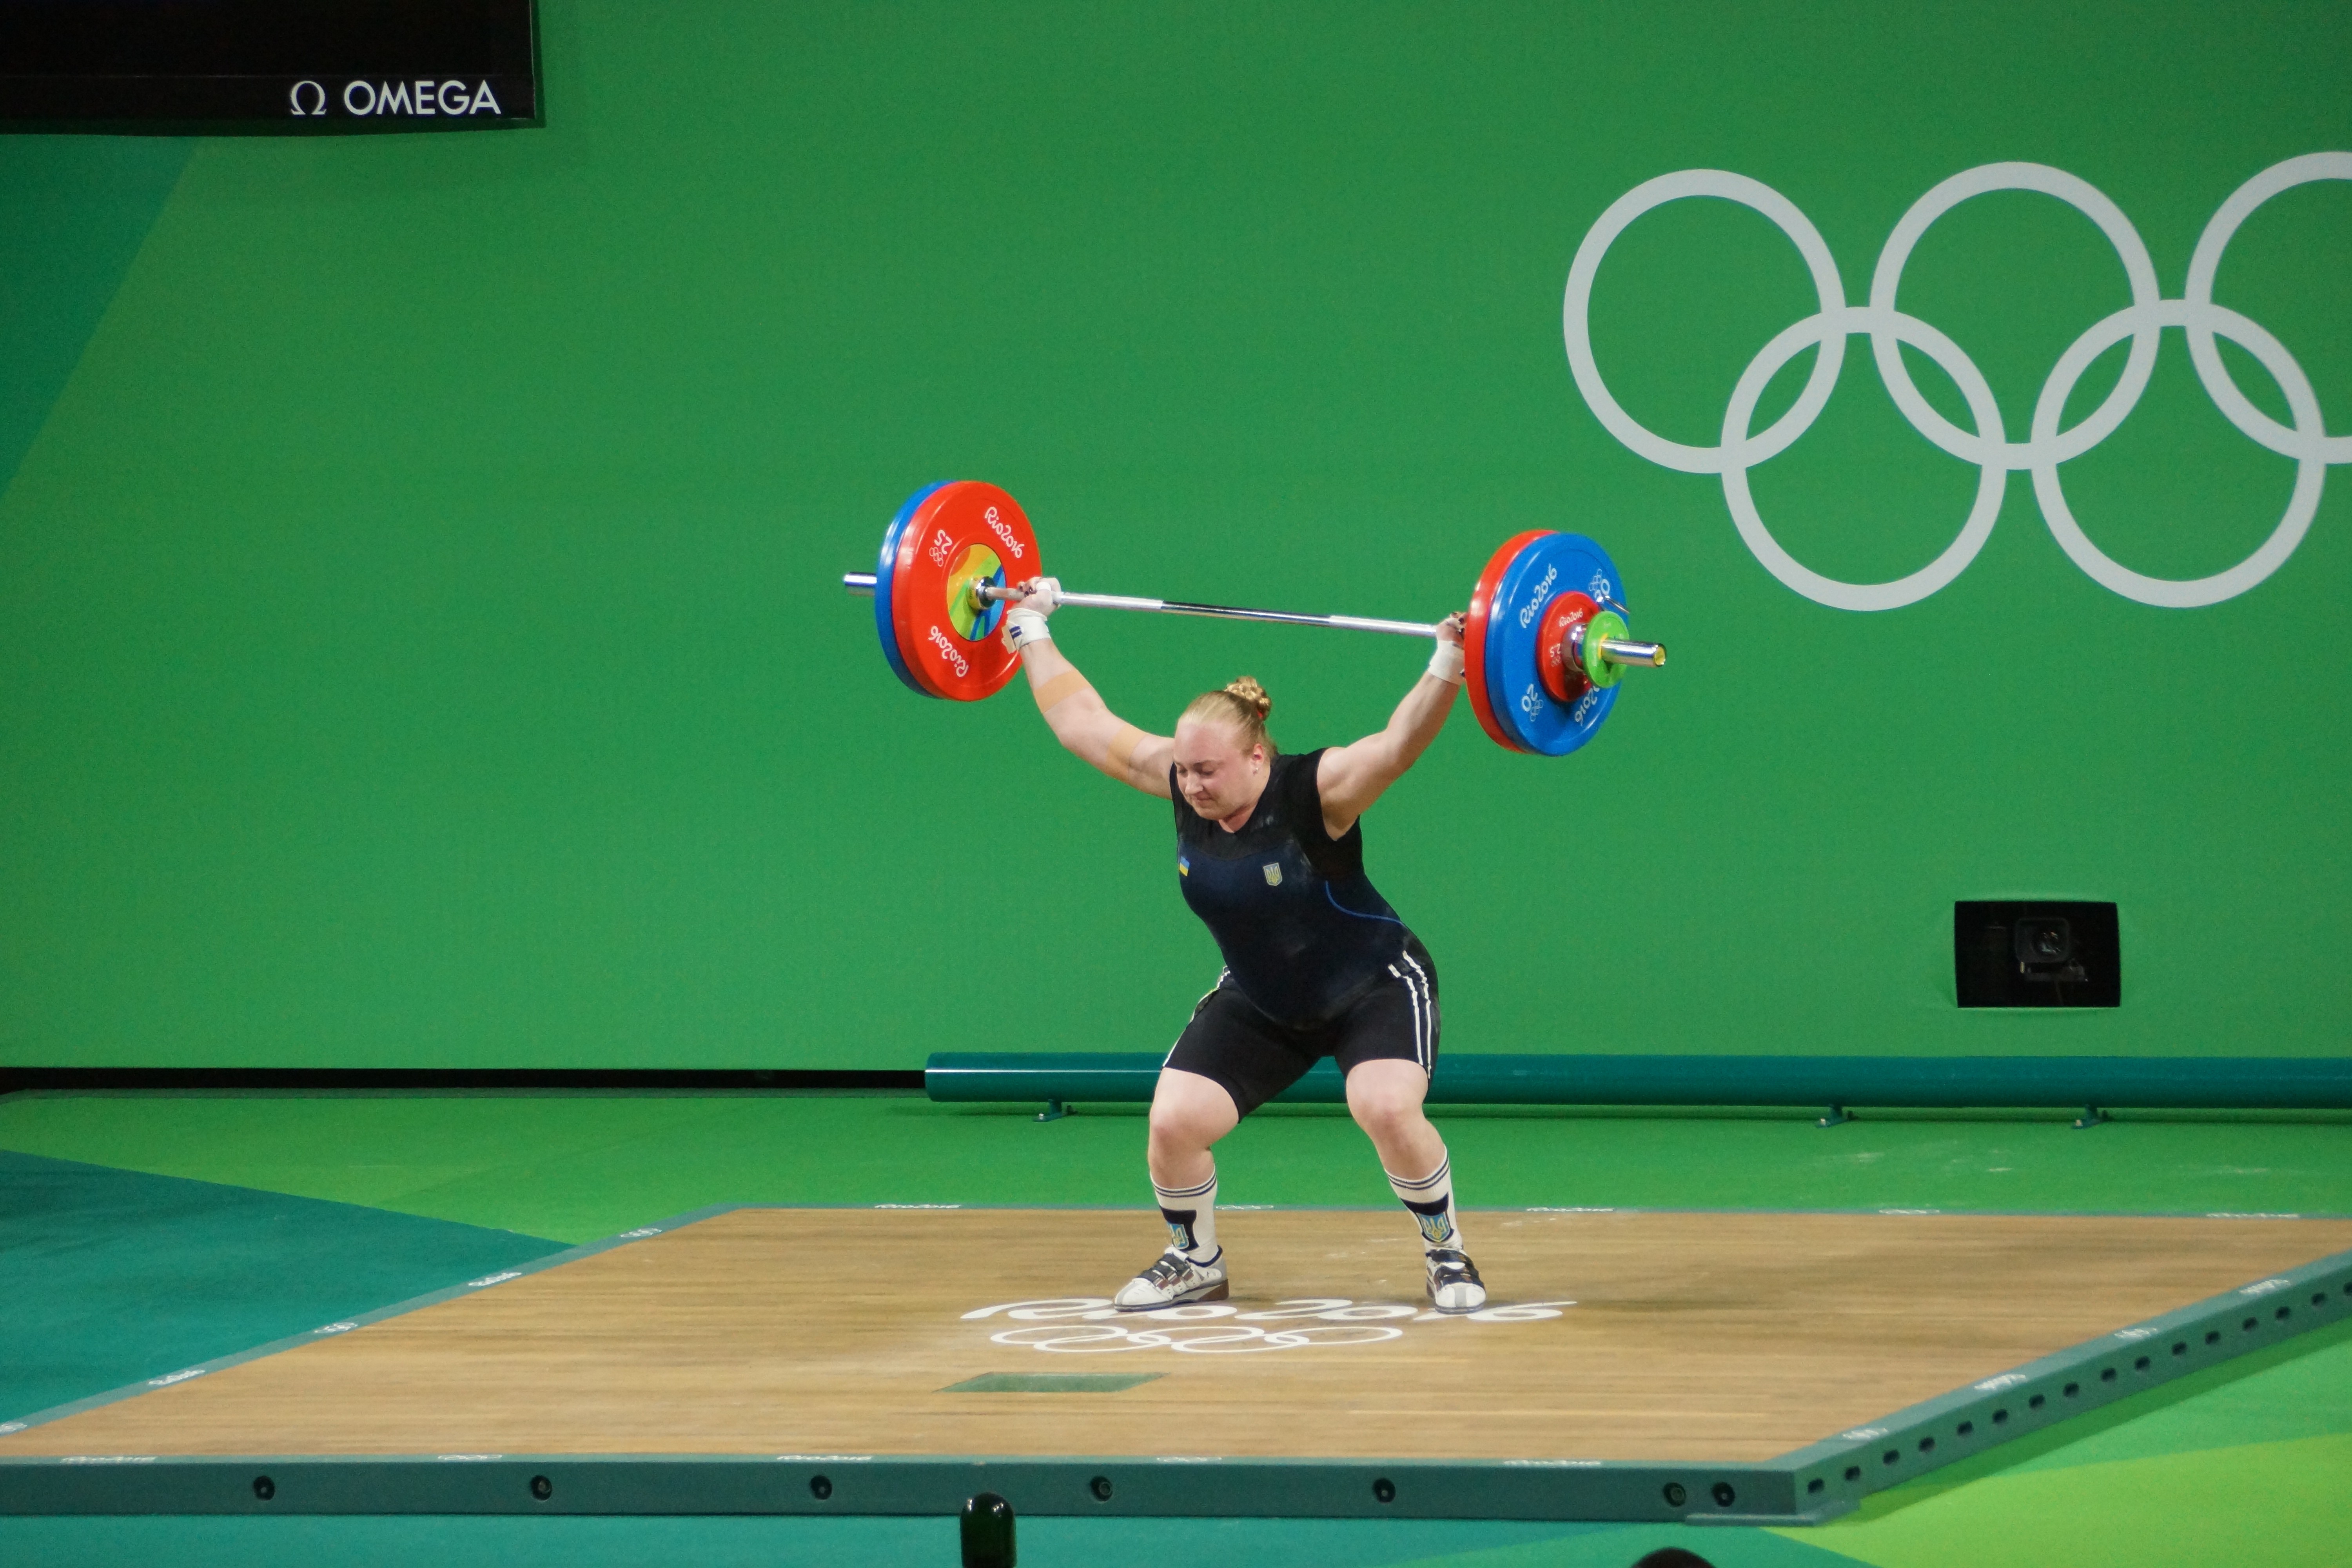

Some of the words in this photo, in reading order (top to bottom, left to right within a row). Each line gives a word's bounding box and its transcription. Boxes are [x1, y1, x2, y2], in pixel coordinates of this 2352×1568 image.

[344, 80, 501, 115] OMEGA
[934, 529, 952, 554] 25
[1522, 684, 1537, 712] 20
